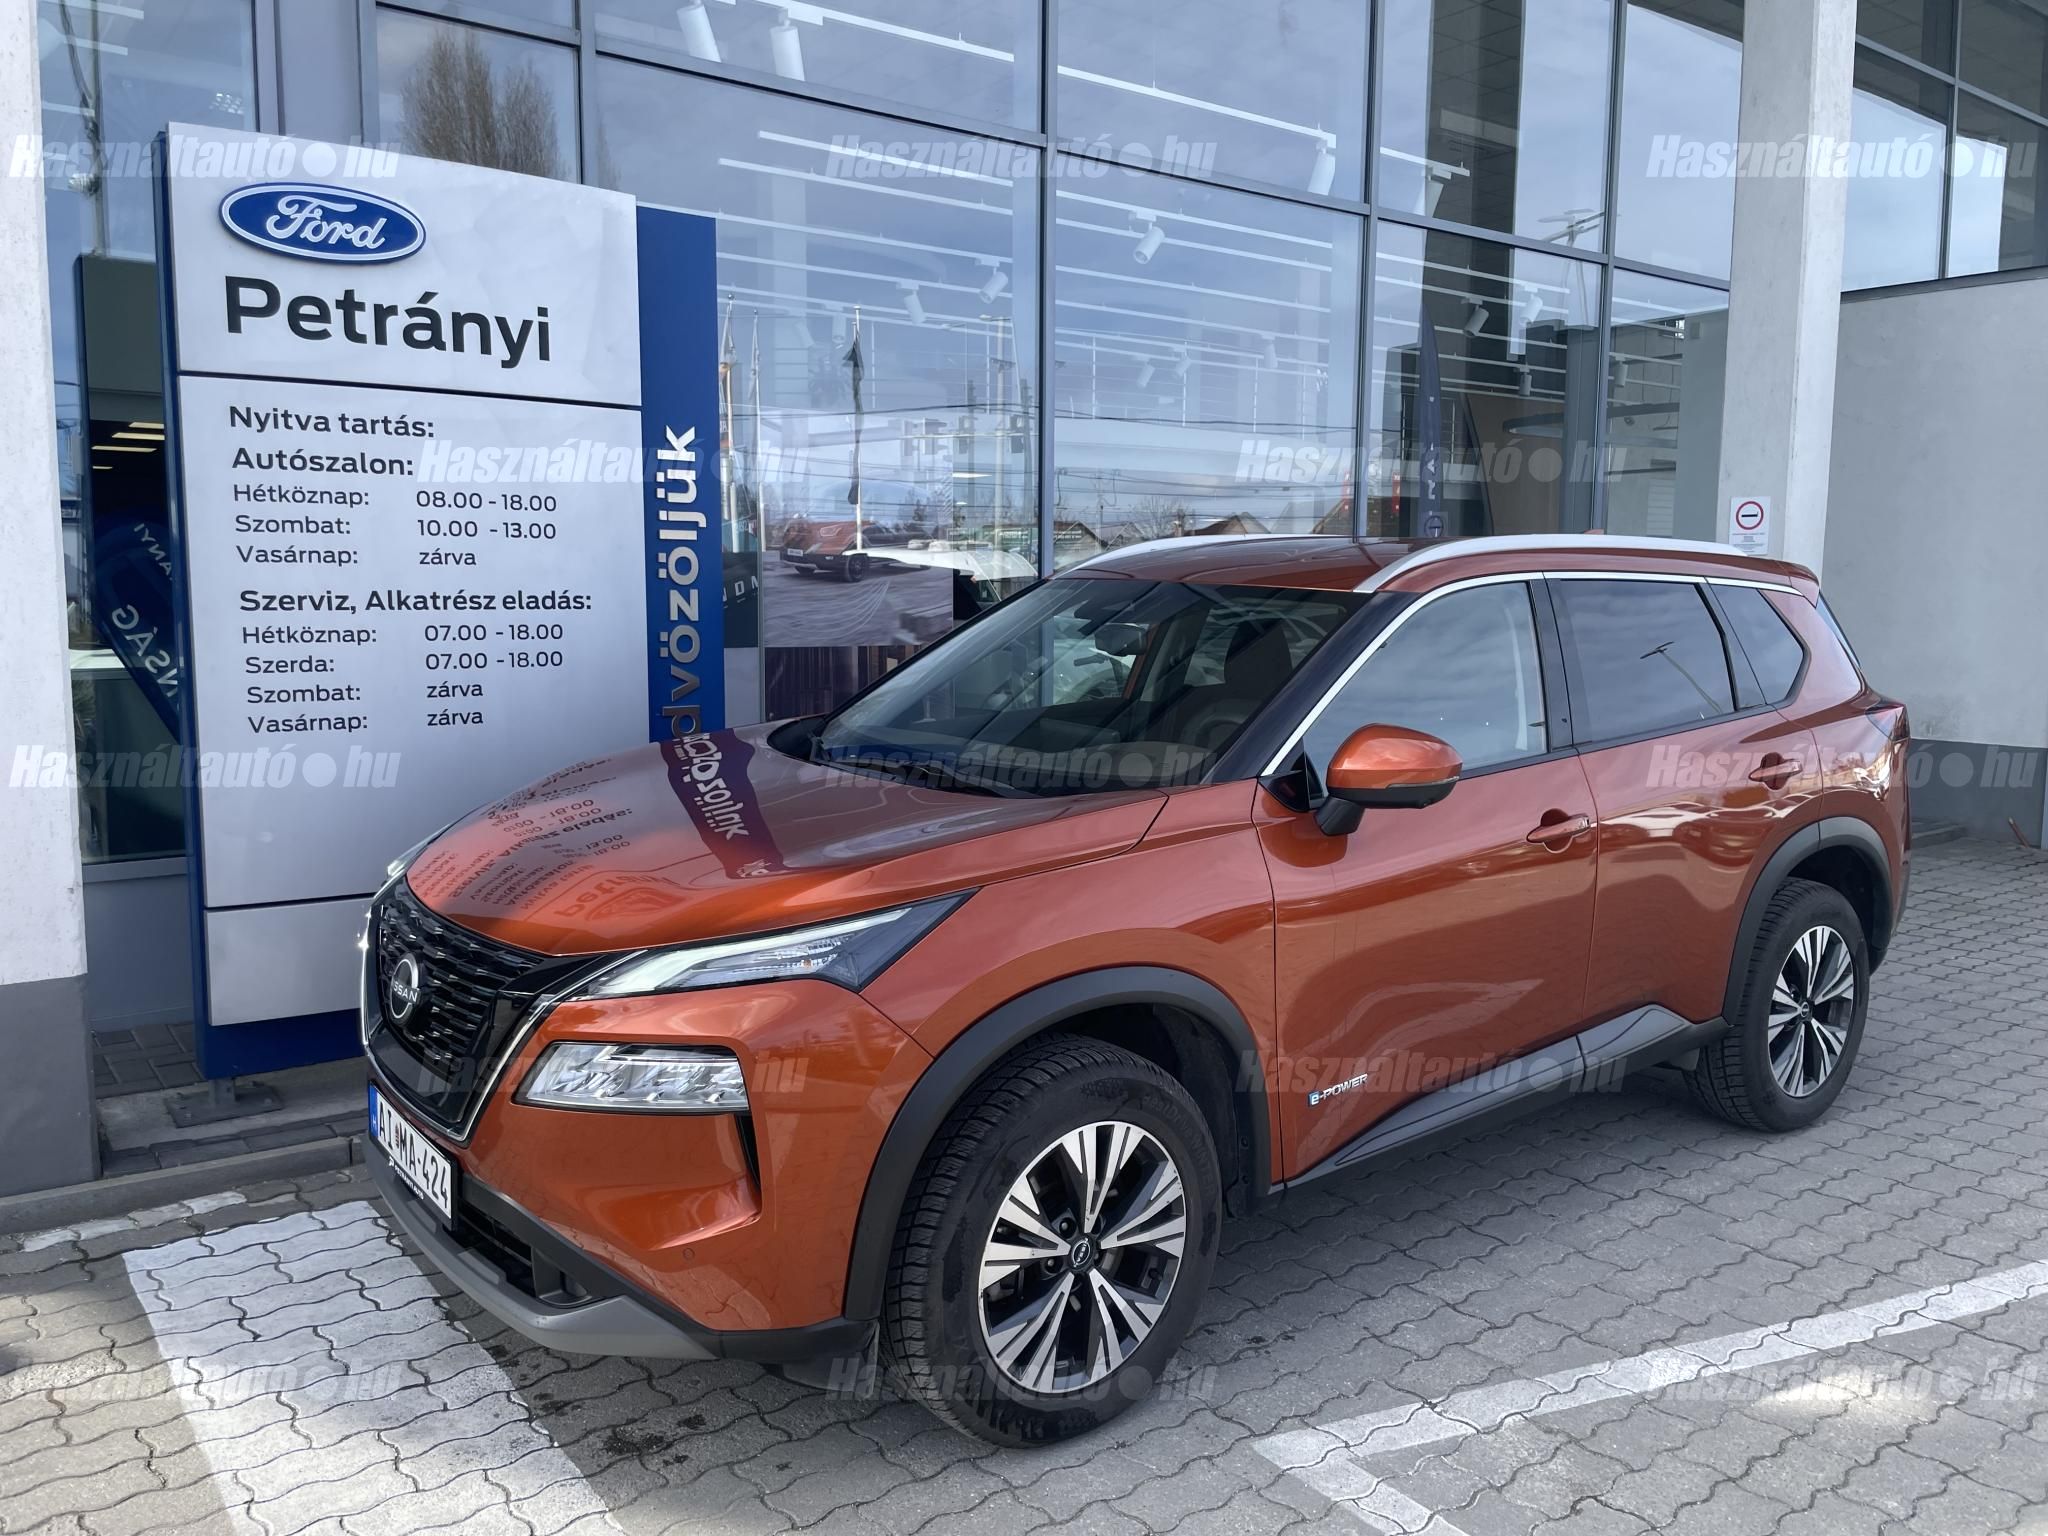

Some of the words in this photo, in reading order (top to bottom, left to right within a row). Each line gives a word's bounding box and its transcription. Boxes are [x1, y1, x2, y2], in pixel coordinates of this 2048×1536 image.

[265, 194, 388, 250] Ford
[225, 275, 551, 369] Petrányi
[229, 405, 331, 433] Nyitva
[338, 413, 435, 438] tartás:
[231, 447, 414, 476] Autószalon:
[233, 483, 370, 508] Hétköznap:
[416, 490, 483, 509] 08.00
[235, 514, 351, 535] Szombat:
[417, 519, 478, 537] 10.00
[236, 545, 359, 567] Vasárnap:
[419, 548, 477, 565] zárva
[656, 424, 707, 739] dvözöljük
[240, 590, 356, 614] Szerviz,
[365, 589, 496, 610] Alkatrész
[502, 590, 592, 610] eladás:
[242, 625, 377, 646] Hétköznap:
[425, 624, 487, 641] 07.00
[245, 655, 335, 674] Szerda:
[426, 653, 487, 670] 07.00
[247, 684, 361, 703] Szombat:
[427, 681, 483, 698] zárva
[248, 714, 368, 733] Vasárnap:
[427, 709, 483, 726] zárva
